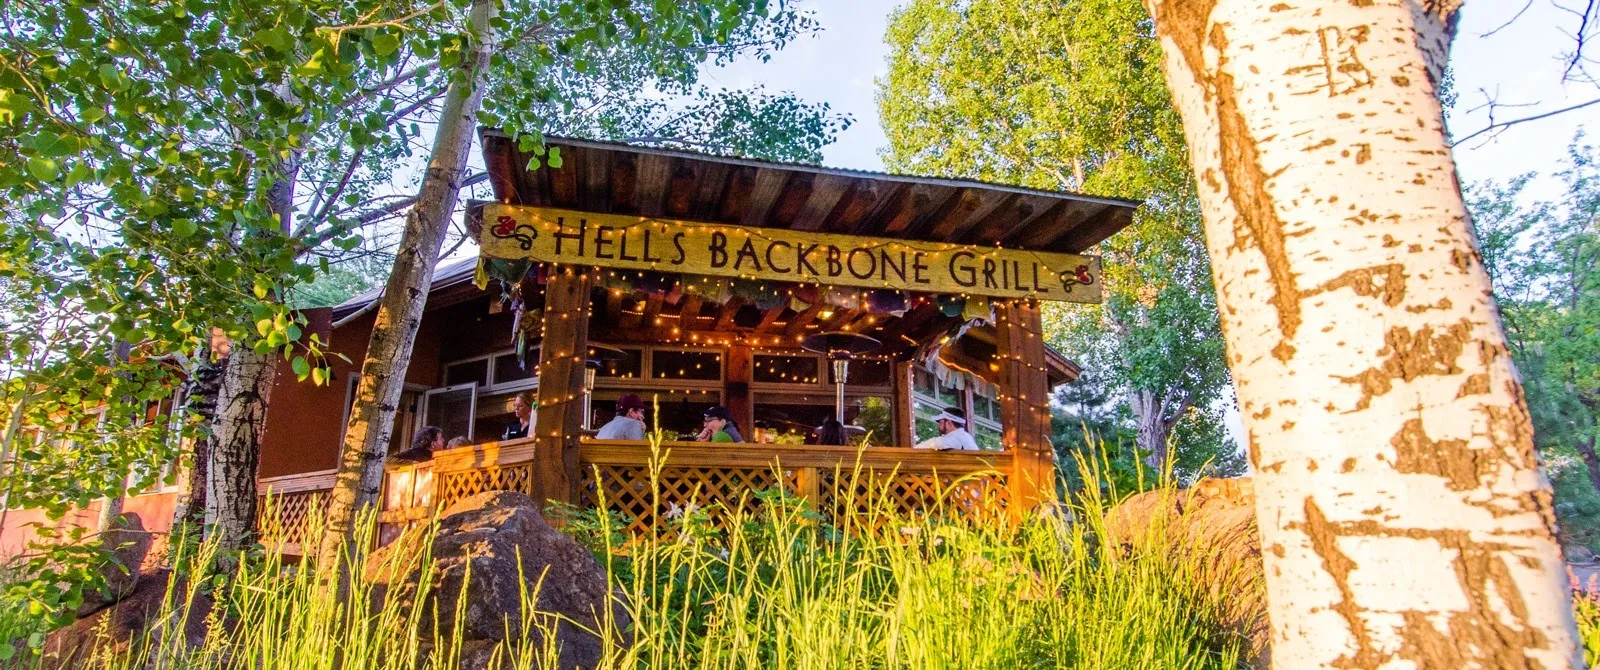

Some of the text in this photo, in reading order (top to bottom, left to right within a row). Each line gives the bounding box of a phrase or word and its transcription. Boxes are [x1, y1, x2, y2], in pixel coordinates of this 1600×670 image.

[553, 217, 1049, 293] HELL'S BACKBONE GRILL
